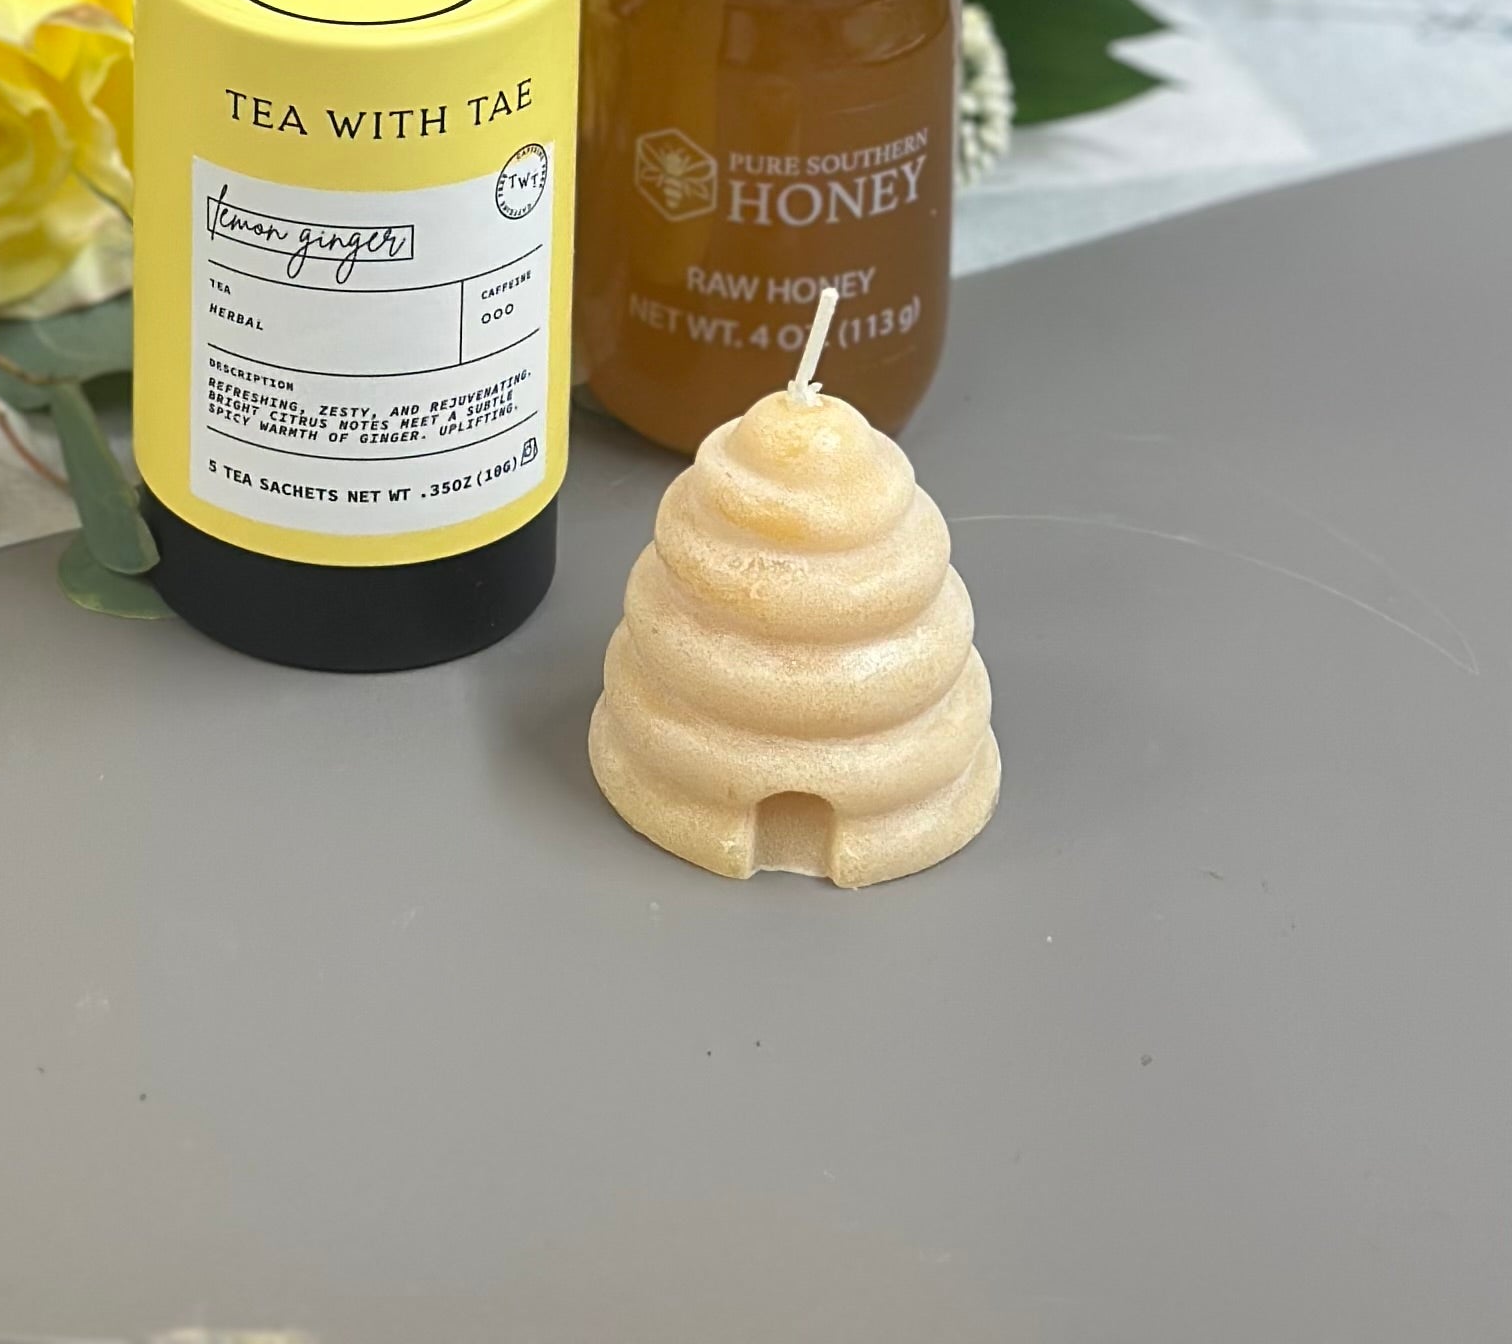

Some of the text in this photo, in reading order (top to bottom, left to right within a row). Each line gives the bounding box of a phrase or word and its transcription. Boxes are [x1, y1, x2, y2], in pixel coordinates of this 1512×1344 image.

[225, 77, 533, 140] TEA WITH TAE
[728, 127, 929, 177] PURE SOUTHERN
[727, 154, 927, 227] HONEY
[211, 184, 406, 284] lemon ginger
[209, 277, 231, 296] TEA
[481, 270, 532, 300] CAFFEINE
[687, 266, 876, 304] RAW HONEY
[209, 302, 264, 331] HERBAL
[630, 293, 679, 333] NET
[688, 314, 743, 349] WT.
[750, 324, 770, 349] 4
[208, 368, 532, 419] REFRESHING, ZESTY, AND REJUVENATING.
[209, 357, 294, 392] DESCRIPTION
[208, 389, 514, 431] BRIGHT CITRUS NOTES MEET A SUBTLE
[208, 402, 519, 444] SPICY WARMTH OF GINGER. UPLIFTING.
[208, 458, 218, 473] 5
[223, 465, 253, 487] TEA
[259, 478, 339, 502] SACHETS
[347, 490, 381, 503] NET
[388, 488, 412, 502] WT
